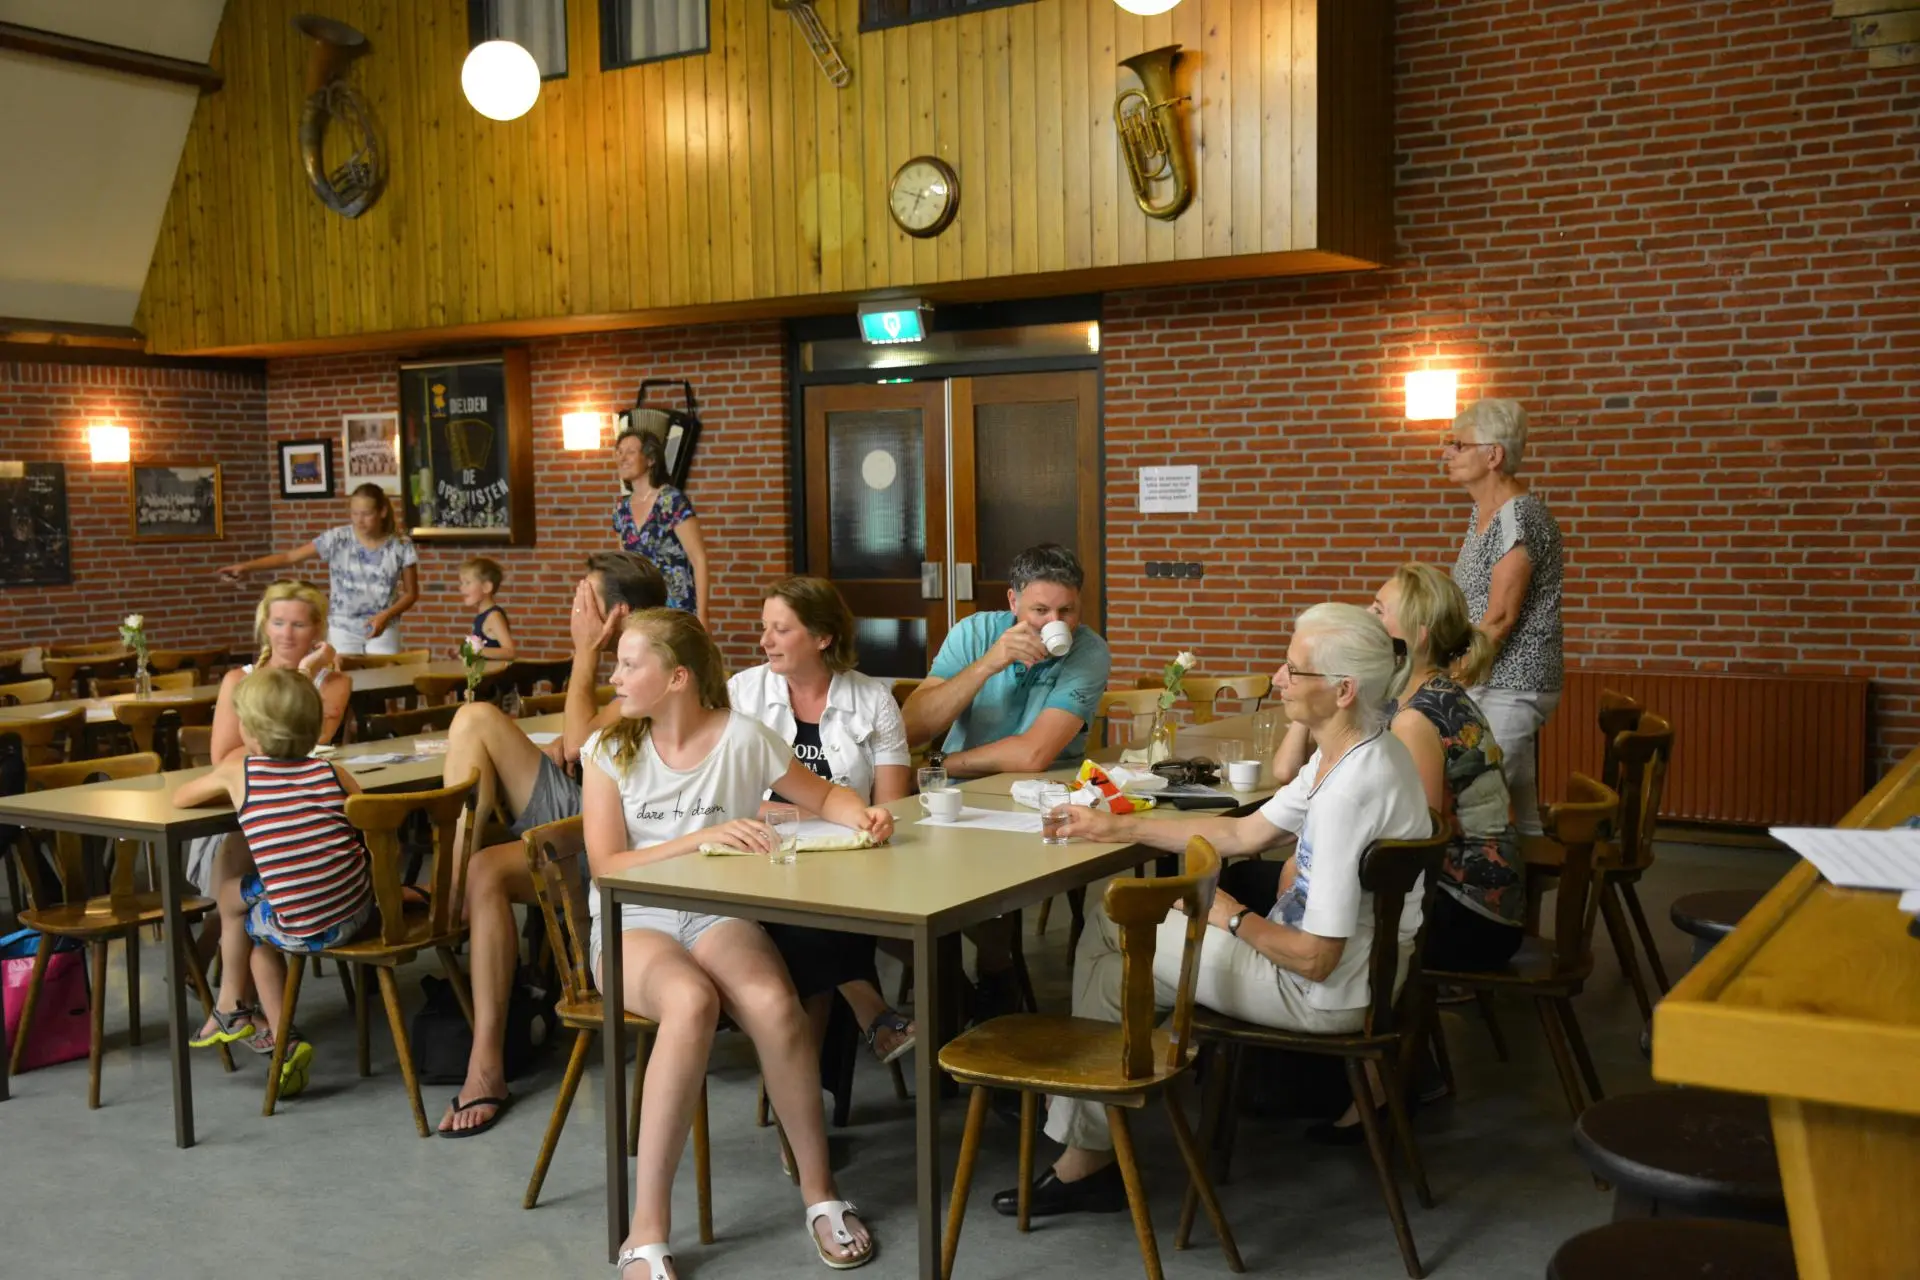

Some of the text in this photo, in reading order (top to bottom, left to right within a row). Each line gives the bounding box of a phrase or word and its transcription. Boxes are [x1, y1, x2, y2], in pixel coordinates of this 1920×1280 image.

[449, 396, 488, 414] DELDEN
[462, 469, 476, 485] DE
[636, 802, 665, 820] dare
[672, 790, 684, 820] to
